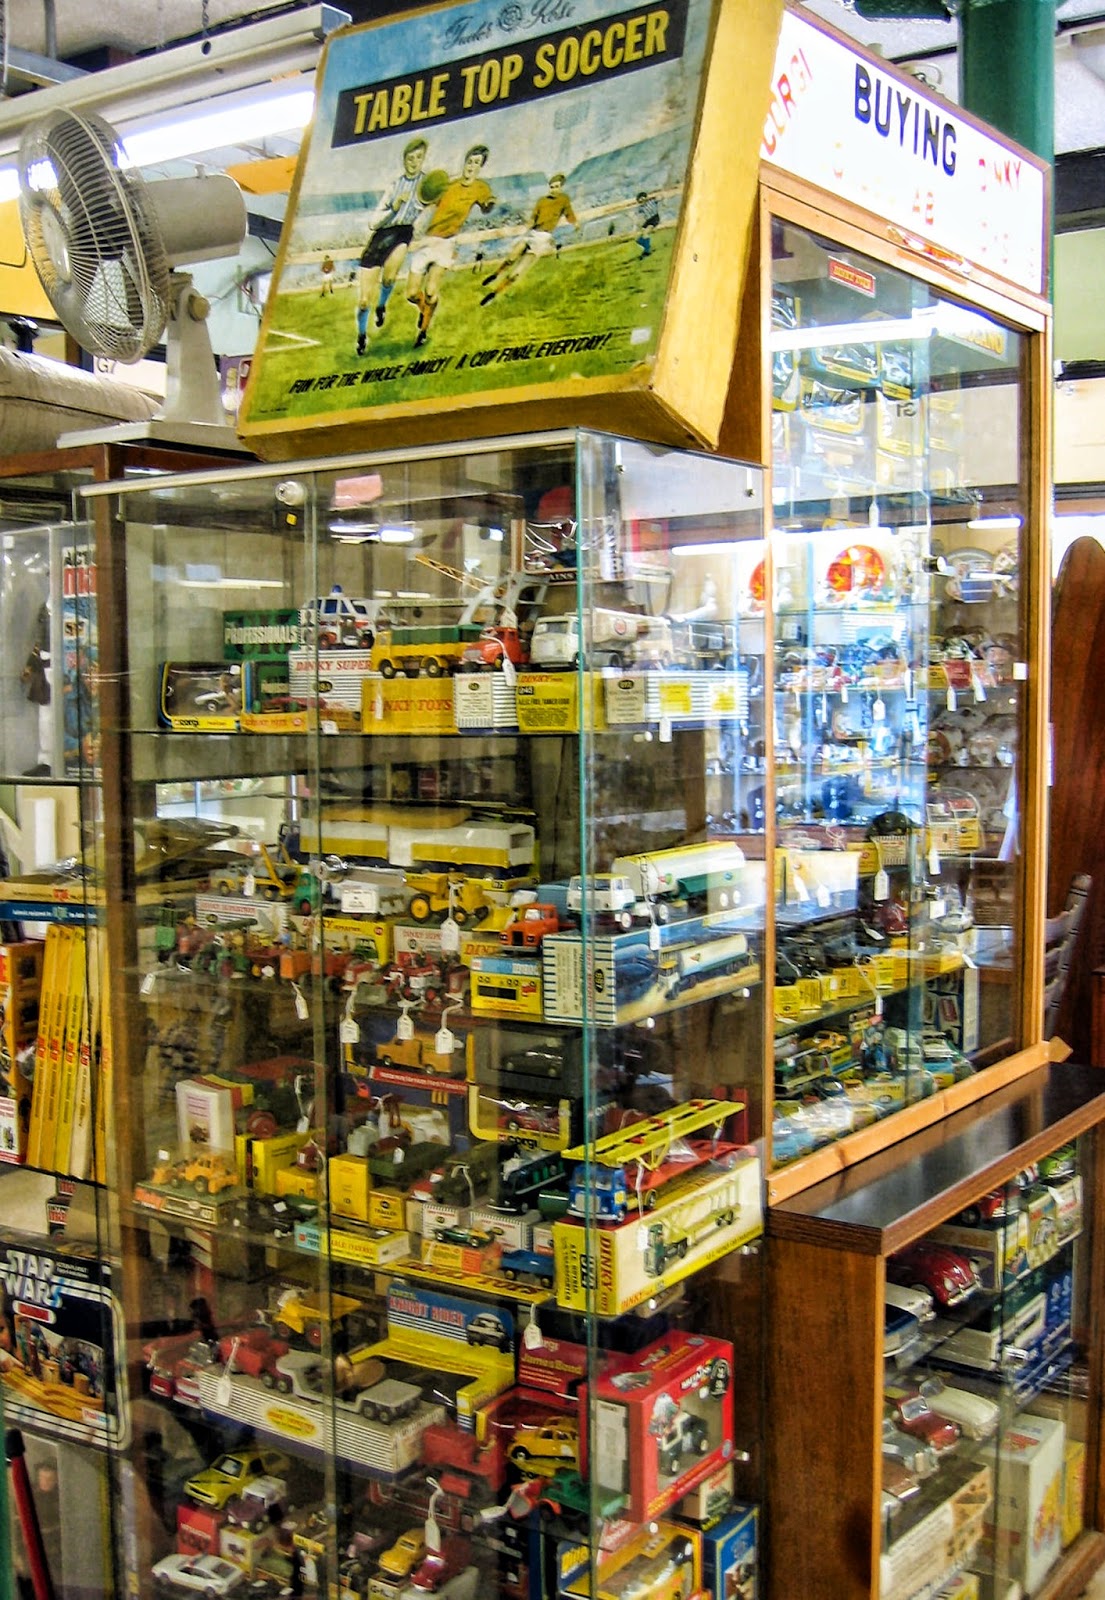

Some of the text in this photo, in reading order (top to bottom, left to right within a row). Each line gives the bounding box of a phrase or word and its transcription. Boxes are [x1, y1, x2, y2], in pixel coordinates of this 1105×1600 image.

[354, 9, 671, 135] TABLE TOP SOCCER
[855, 63, 957, 177] BUYING
[289, 333, 612, 393] FUN FOR THE WHOLE FAMILY! A CUP FINAL EVERYDAY!
[224, 626, 298, 645] PROFESSIONALS
[296, 661, 333, 671] DINKY
[418, 699, 453, 712] TOYS
[6, 1249, 55, 1281] STAR
[601, 1235, 612, 1292] DINKY
[6, 1272, 63, 1309] WARS
[389, 1297, 428, 1318] KNIGHT
[555, 1359, 583, 1375] Bond
